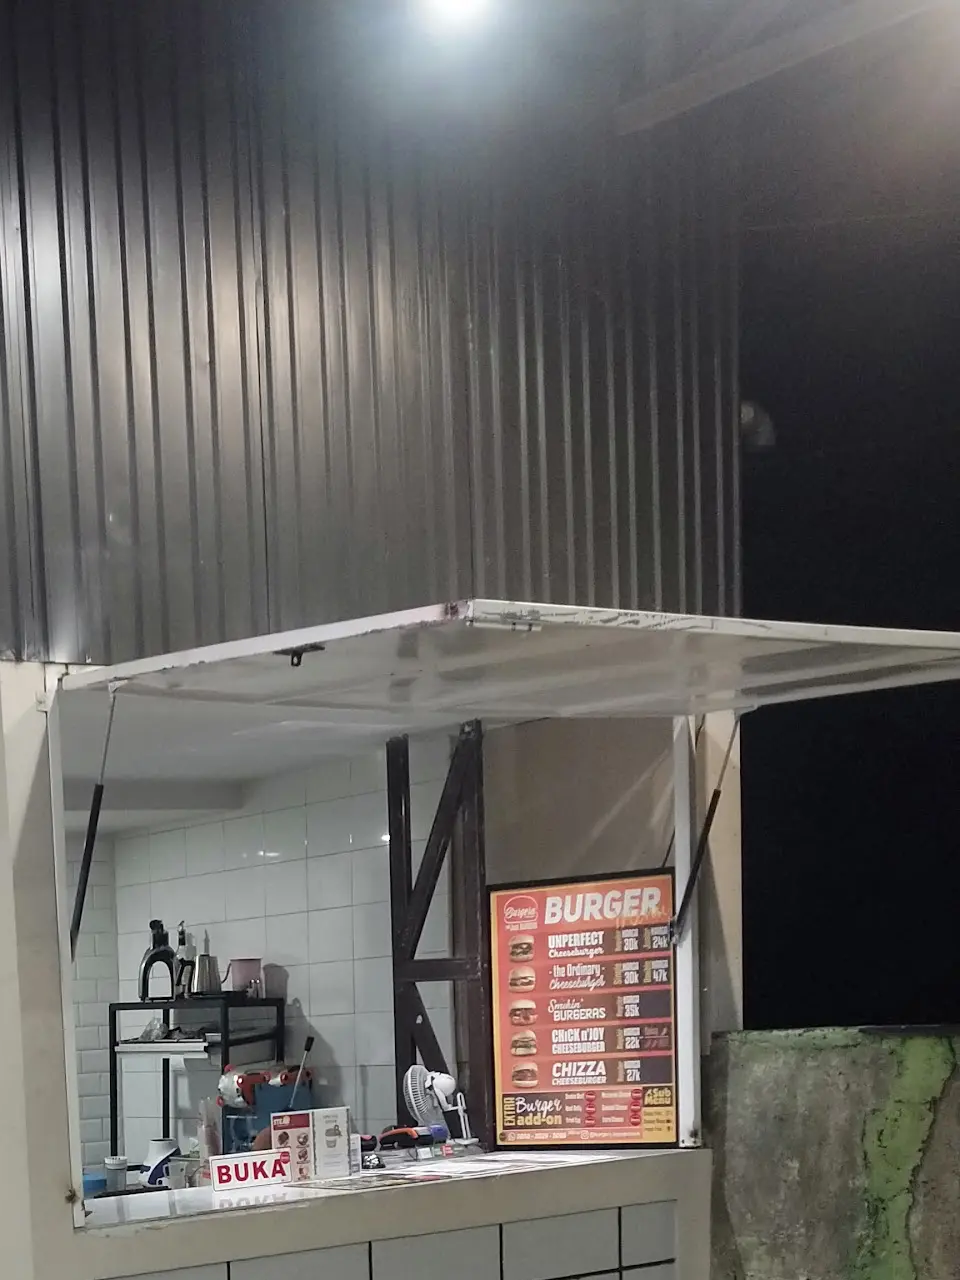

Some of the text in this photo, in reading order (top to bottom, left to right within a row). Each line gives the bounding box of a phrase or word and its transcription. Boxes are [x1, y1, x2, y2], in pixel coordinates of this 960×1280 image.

[544, 887, 661, 924] BURGER
[548, 931, 605, 949] UNPERFECT
[548, 947, 605, 959] Cheeseburger
[553, 964, 566, 978] the
[566, 963, 601, 978] Ordinary
[553, 1007, 606, 1022] BURGERAS
[552, 1041, 606, 1055] CHEESEBURGER
[552, 1060, 607, 1077] CHIZZA
[552, 1076, 607, 1086] CHEESEBURGER
[515, 1096, 562, 1118] Burger
[517, 1112, 563, 1126] add-on
[216, 1158, 287, 1185] BUKA
